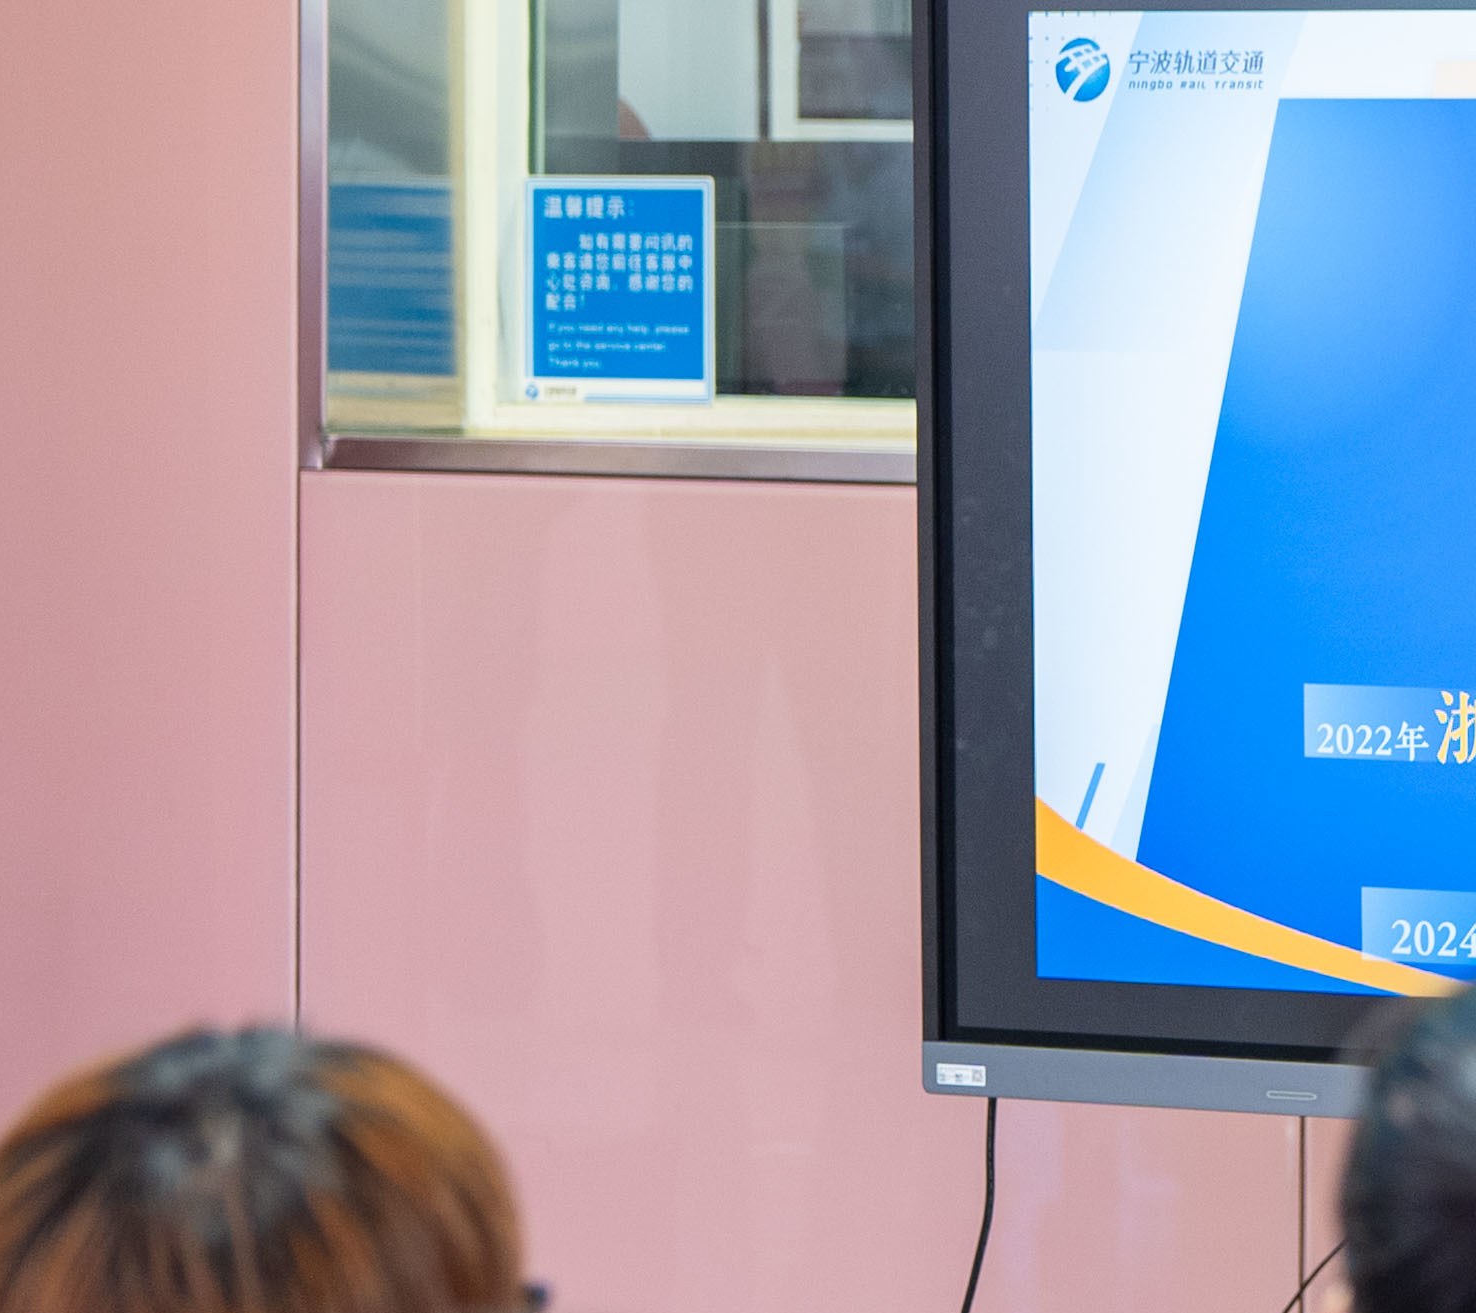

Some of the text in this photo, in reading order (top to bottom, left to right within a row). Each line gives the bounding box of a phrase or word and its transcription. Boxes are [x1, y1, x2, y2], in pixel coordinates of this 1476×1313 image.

[1129, 50, 1264, 76] 宁波轨道交通
